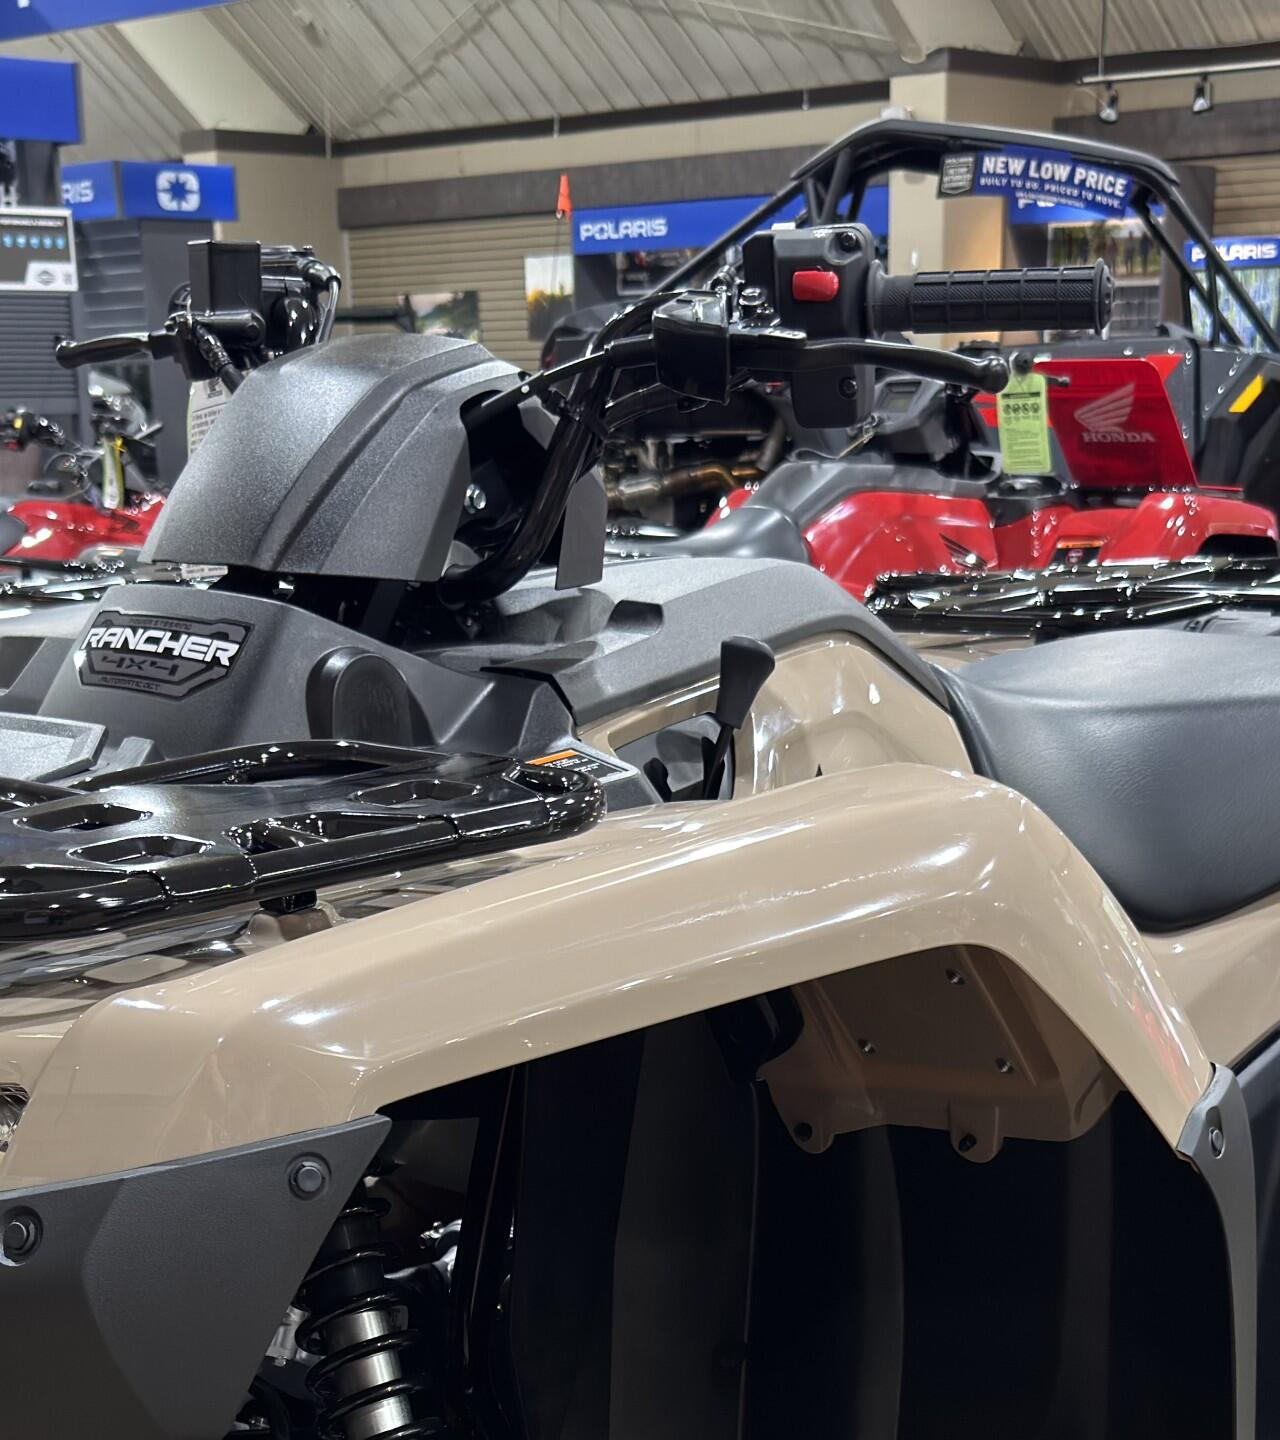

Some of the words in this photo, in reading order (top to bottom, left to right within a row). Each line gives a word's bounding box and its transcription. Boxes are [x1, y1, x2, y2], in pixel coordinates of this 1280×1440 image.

[982, 155, 1026, 175] NEW
[1028, 160, 1073, 182] LOW
[1073, 168, 1128, 197] PRICE
[1010, 179, 1022, 188] TO
[1044, 182, 1079, 197] PRICED
[1081, 190, 1094, 201] TO
[579, 217, 669, 242] POLARIS
[1191, 243, 1278, 263] PLARIS
[1081, 431, 1156, 443] HONDA
[81, 626, 240, 667] RANCHER
